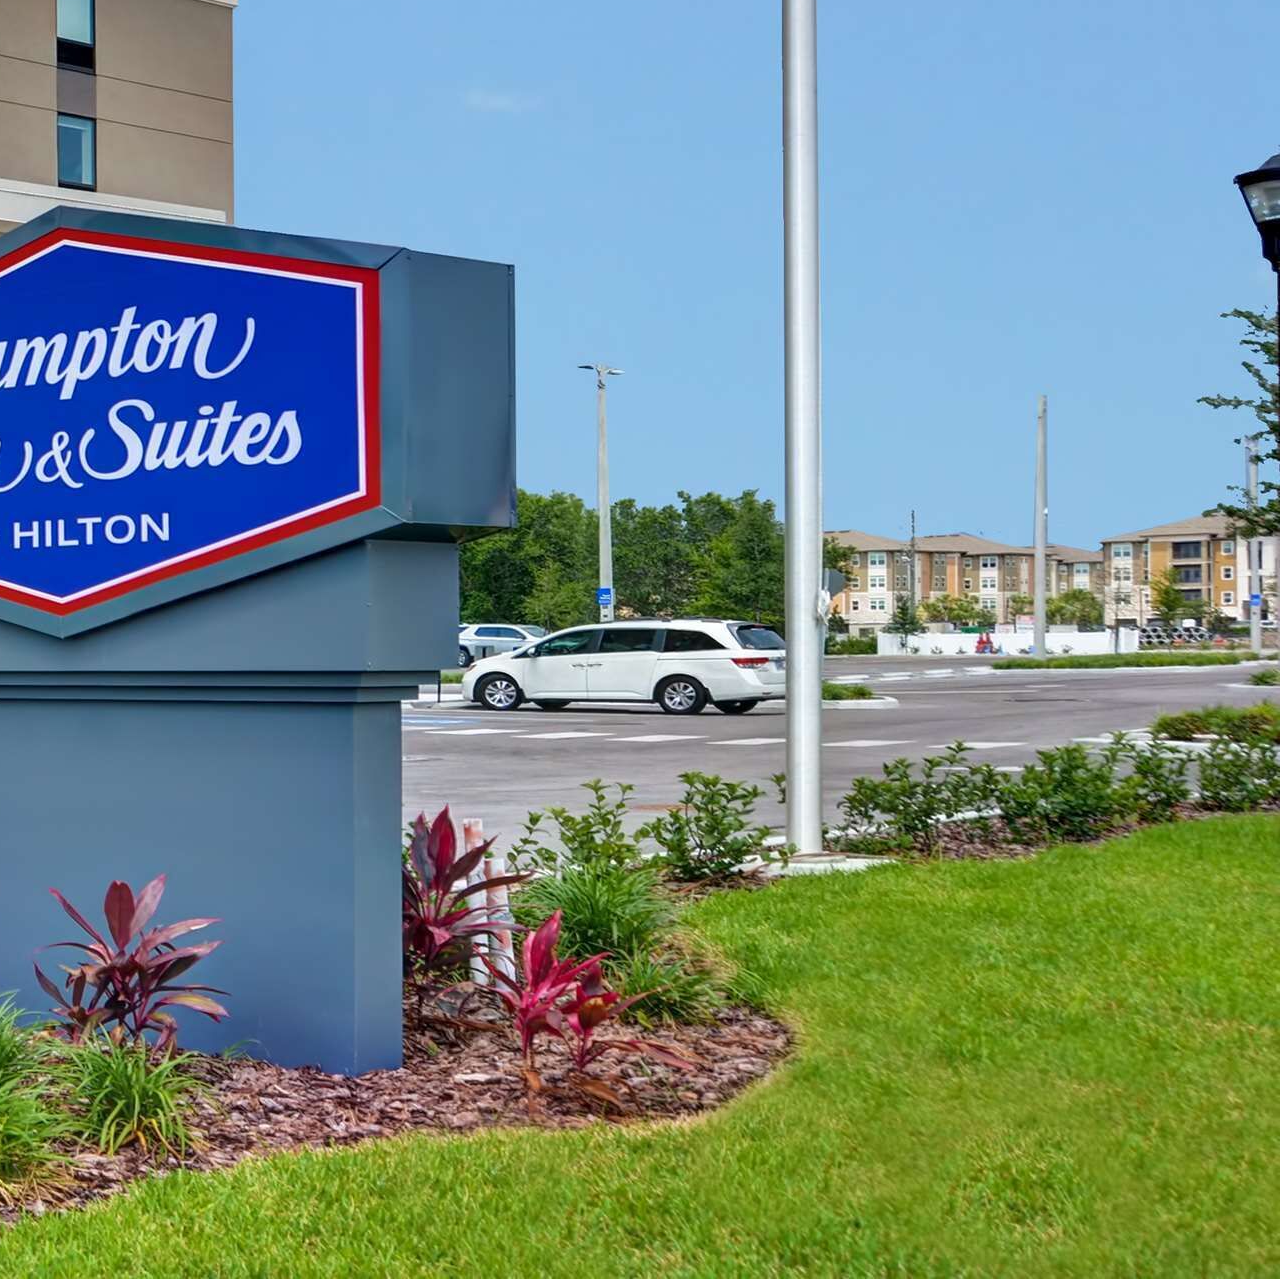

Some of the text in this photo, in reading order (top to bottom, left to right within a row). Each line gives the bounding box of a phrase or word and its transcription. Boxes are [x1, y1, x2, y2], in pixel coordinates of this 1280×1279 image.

[34, 431, 84, 489] &
[78, 399, 303, 480] Suites
[12, 512, 171, 550] HILTON
